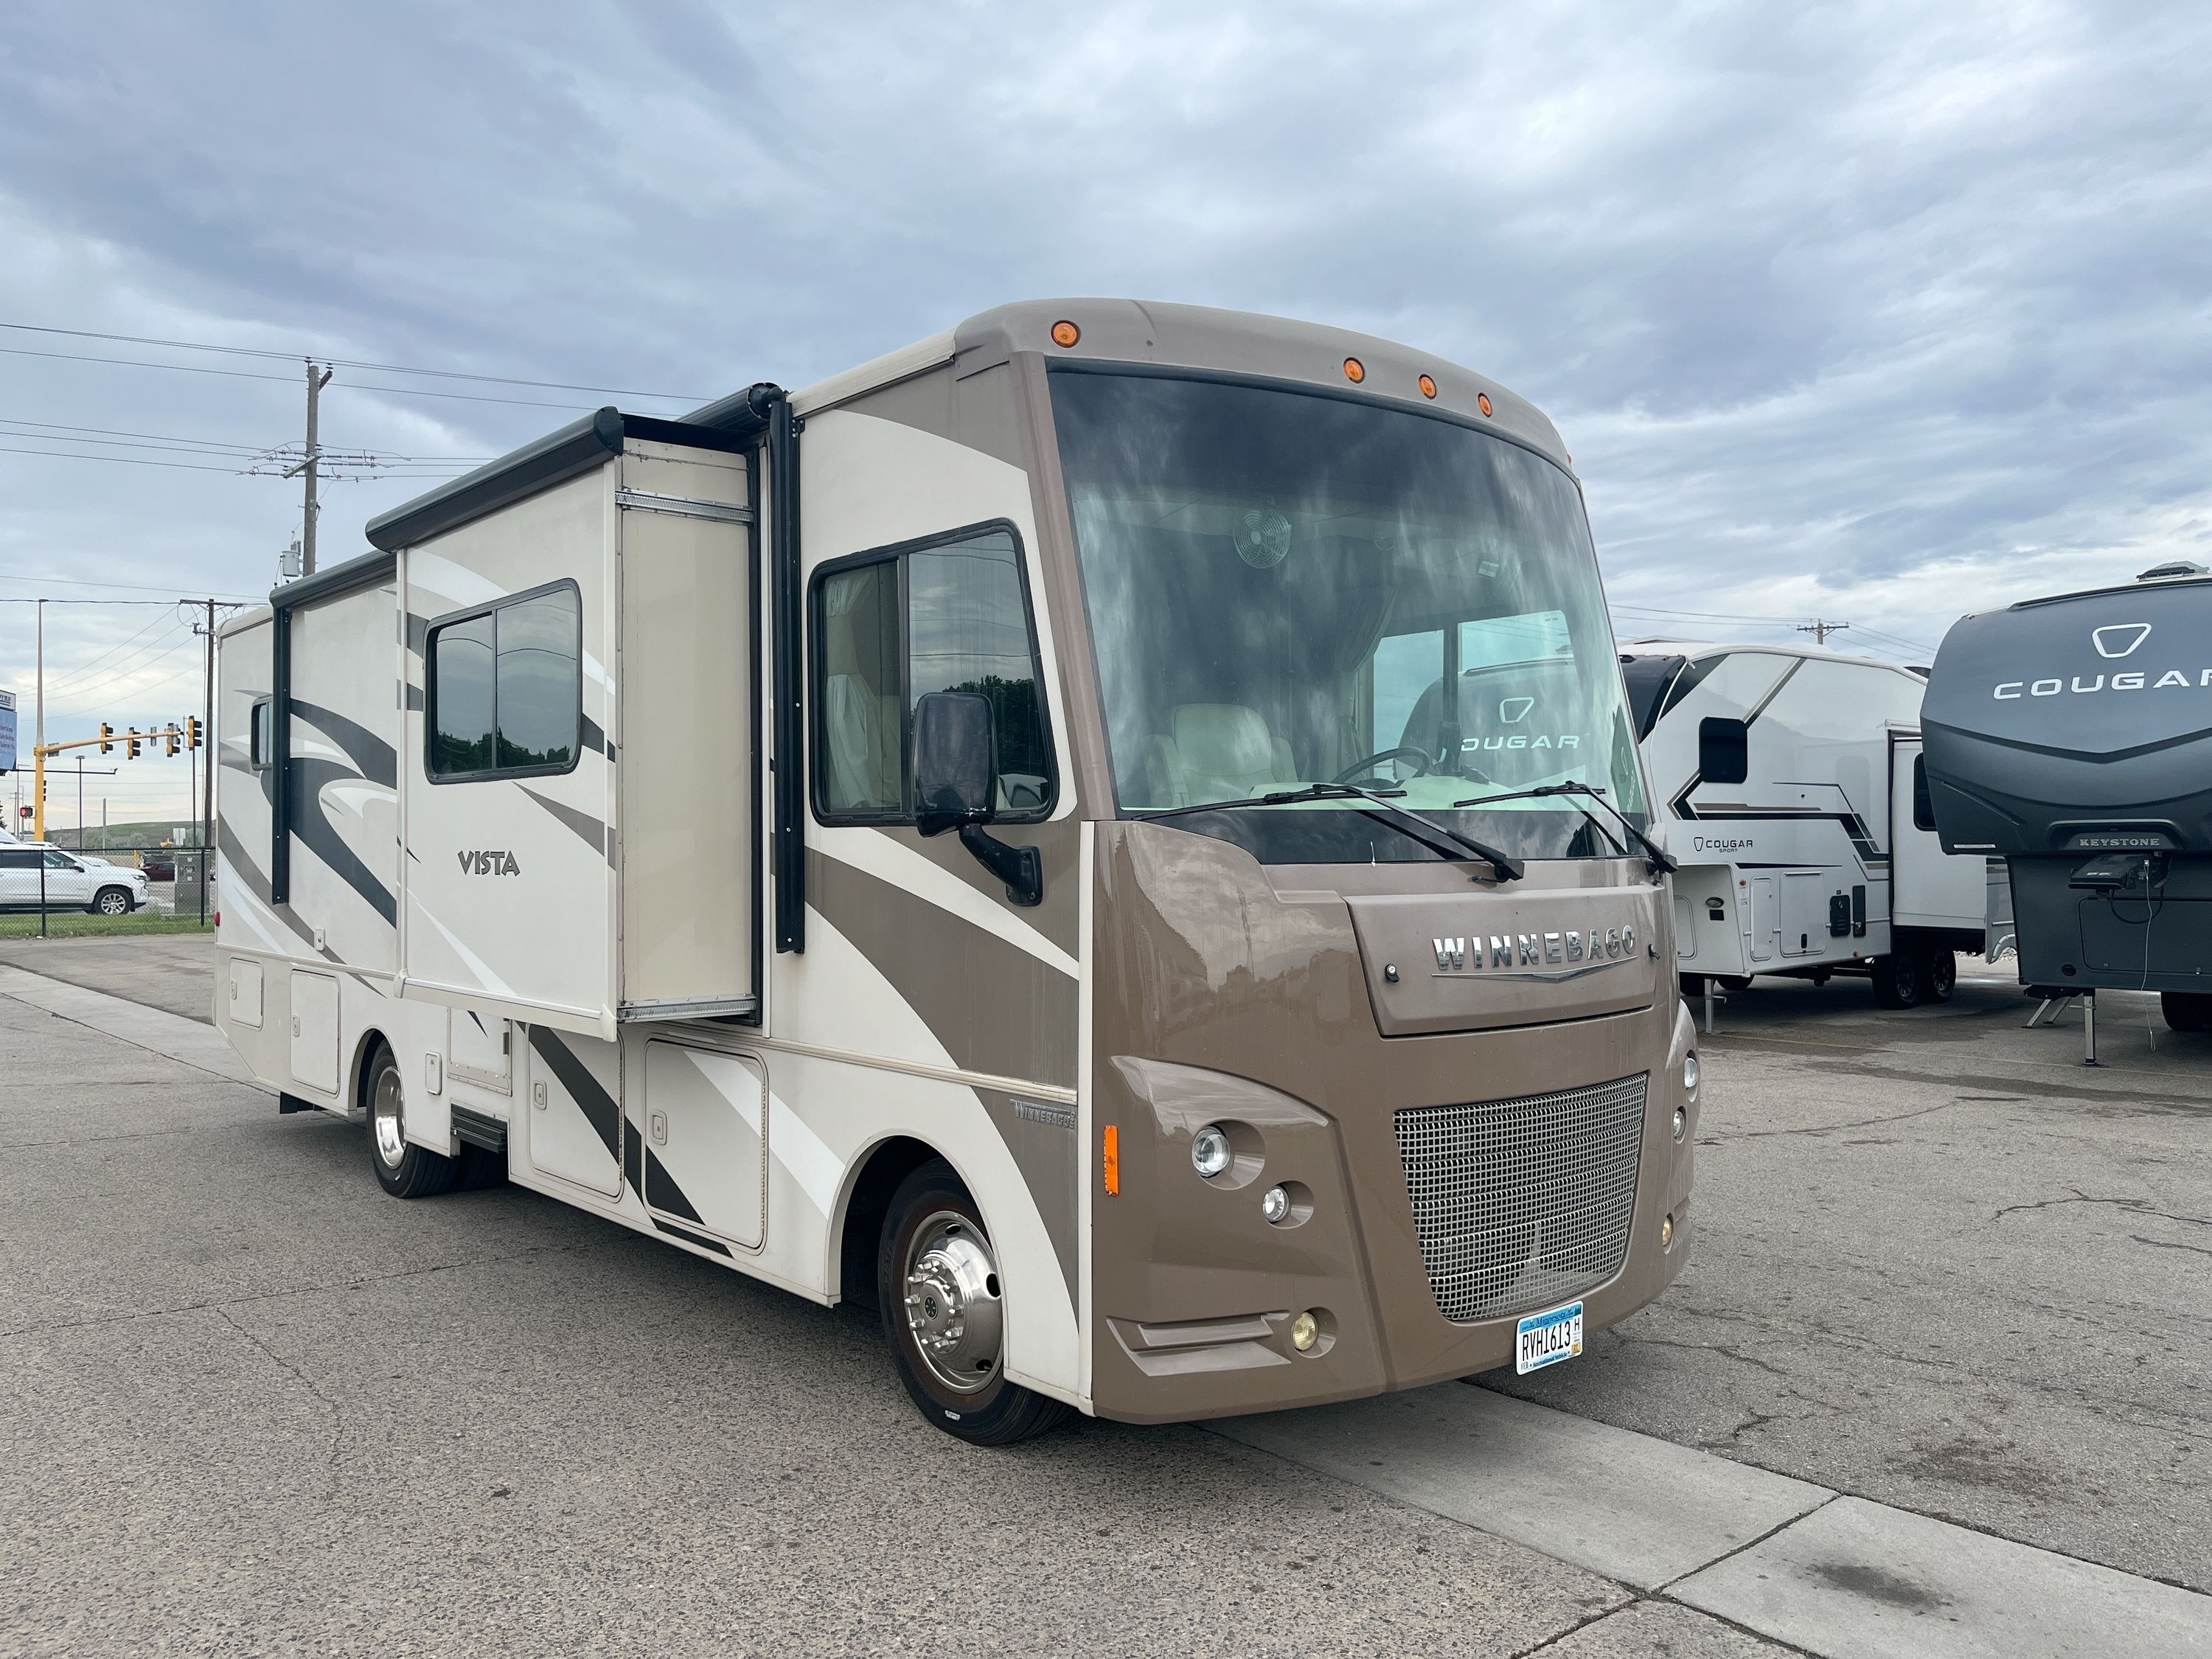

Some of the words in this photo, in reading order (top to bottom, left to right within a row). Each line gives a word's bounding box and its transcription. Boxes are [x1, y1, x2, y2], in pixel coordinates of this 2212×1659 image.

[1461, 735, 1580, 751] OUGAR
[1705, 840, 1753, 848] COUGAR
[2079, 838, 2160, 846] KEYSTONE
[457, 850, 521, 877] VISTA
[1432, 925, 1636, 970] WINNEBAGO
[1523, 1321, 1571, 1362] RVH1613
